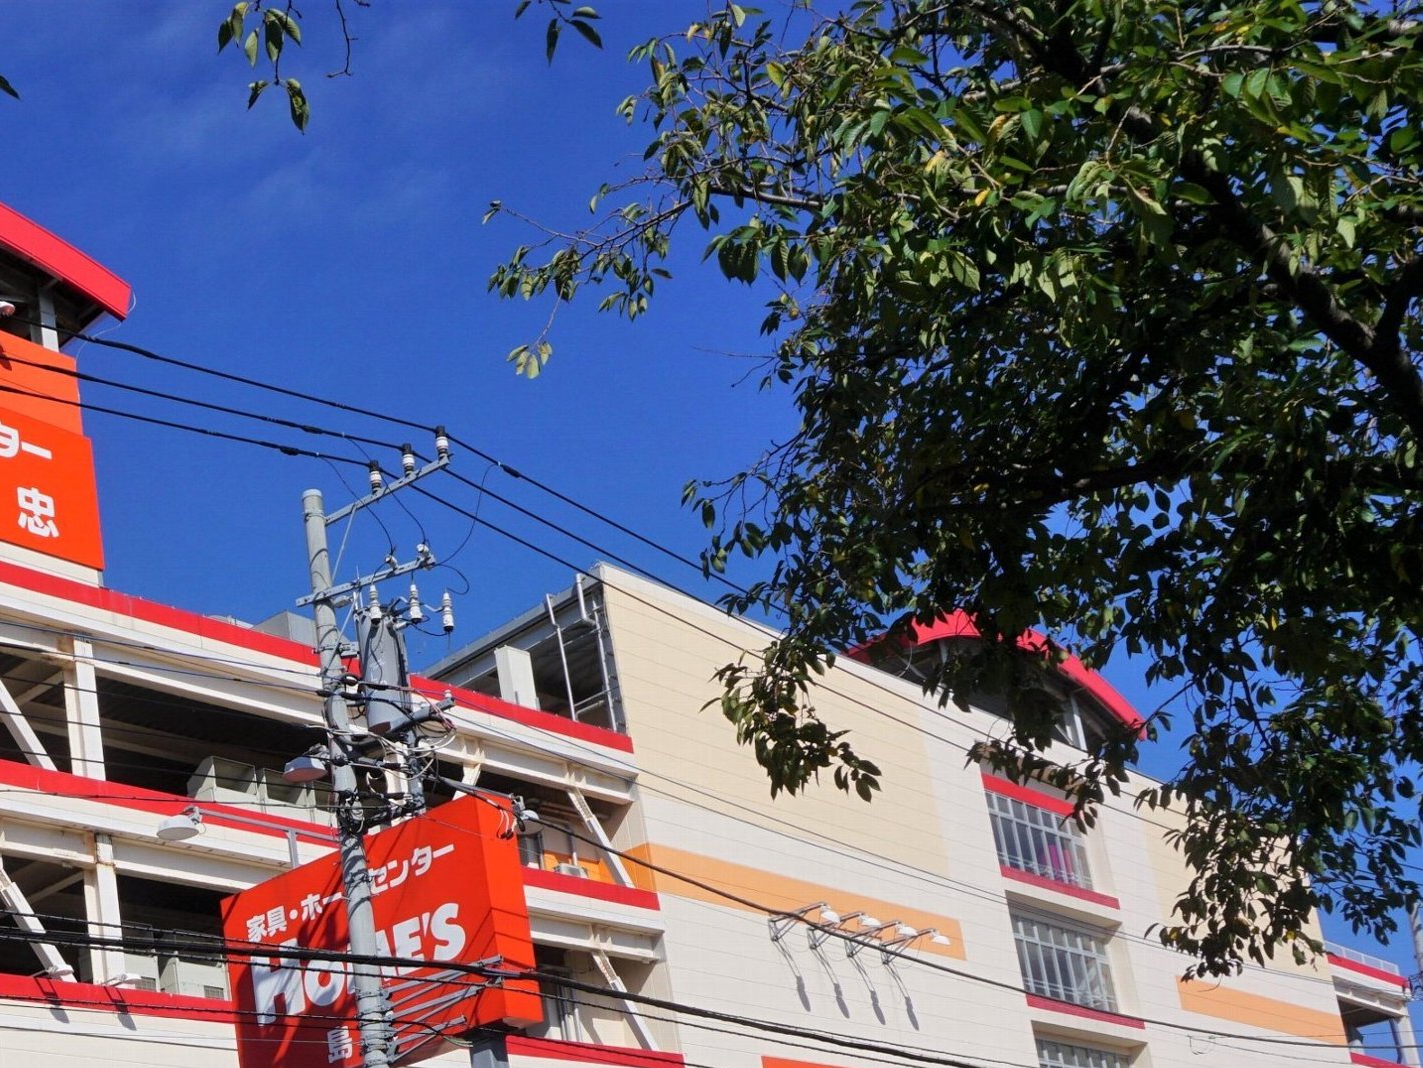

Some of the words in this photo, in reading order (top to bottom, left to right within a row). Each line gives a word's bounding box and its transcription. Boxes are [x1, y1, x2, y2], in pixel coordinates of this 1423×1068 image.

[246, 844, 455, 943] 家具・ホーセンター
